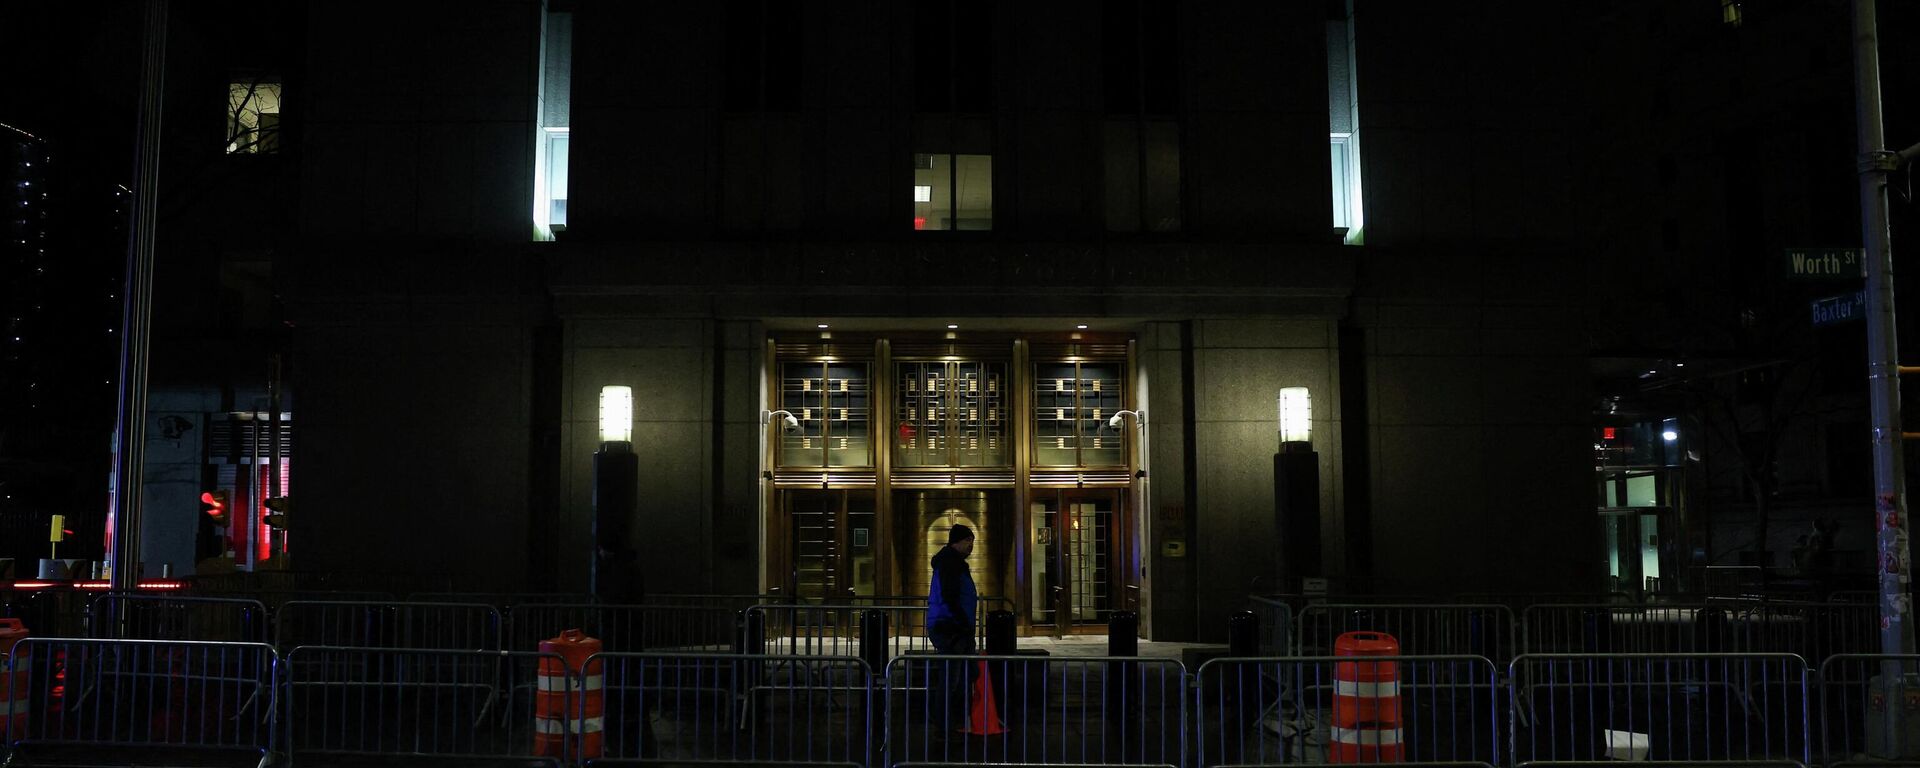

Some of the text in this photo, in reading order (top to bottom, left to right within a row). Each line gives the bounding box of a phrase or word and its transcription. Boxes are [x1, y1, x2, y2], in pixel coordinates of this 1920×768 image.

[1792, 251, 1856, 274] Worth St
[1812, 299, 1852, 323] Baxter
